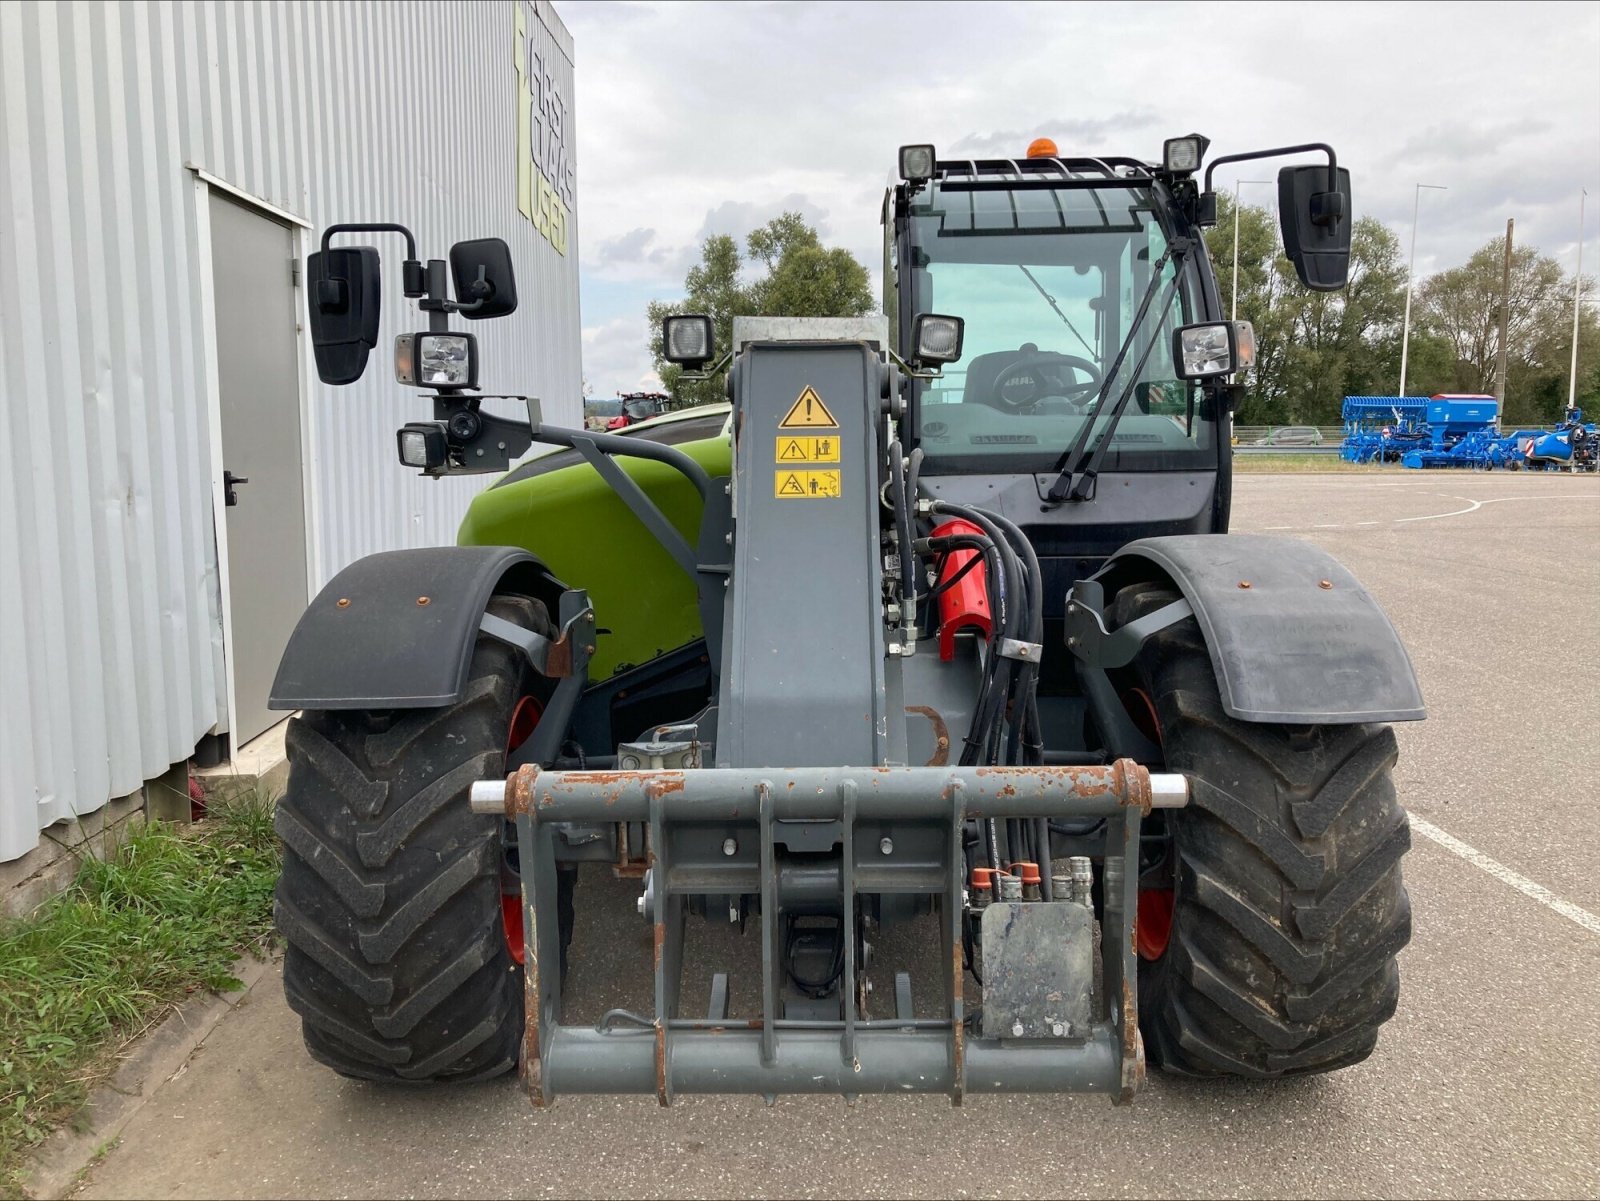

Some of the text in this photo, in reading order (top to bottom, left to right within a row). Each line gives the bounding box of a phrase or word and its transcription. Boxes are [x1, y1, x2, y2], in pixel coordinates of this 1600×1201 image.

[529, 37, 568, 149] FIRST
[529, 161, 568, 258] USED
[530, 101, 573, 214] CLAAS
